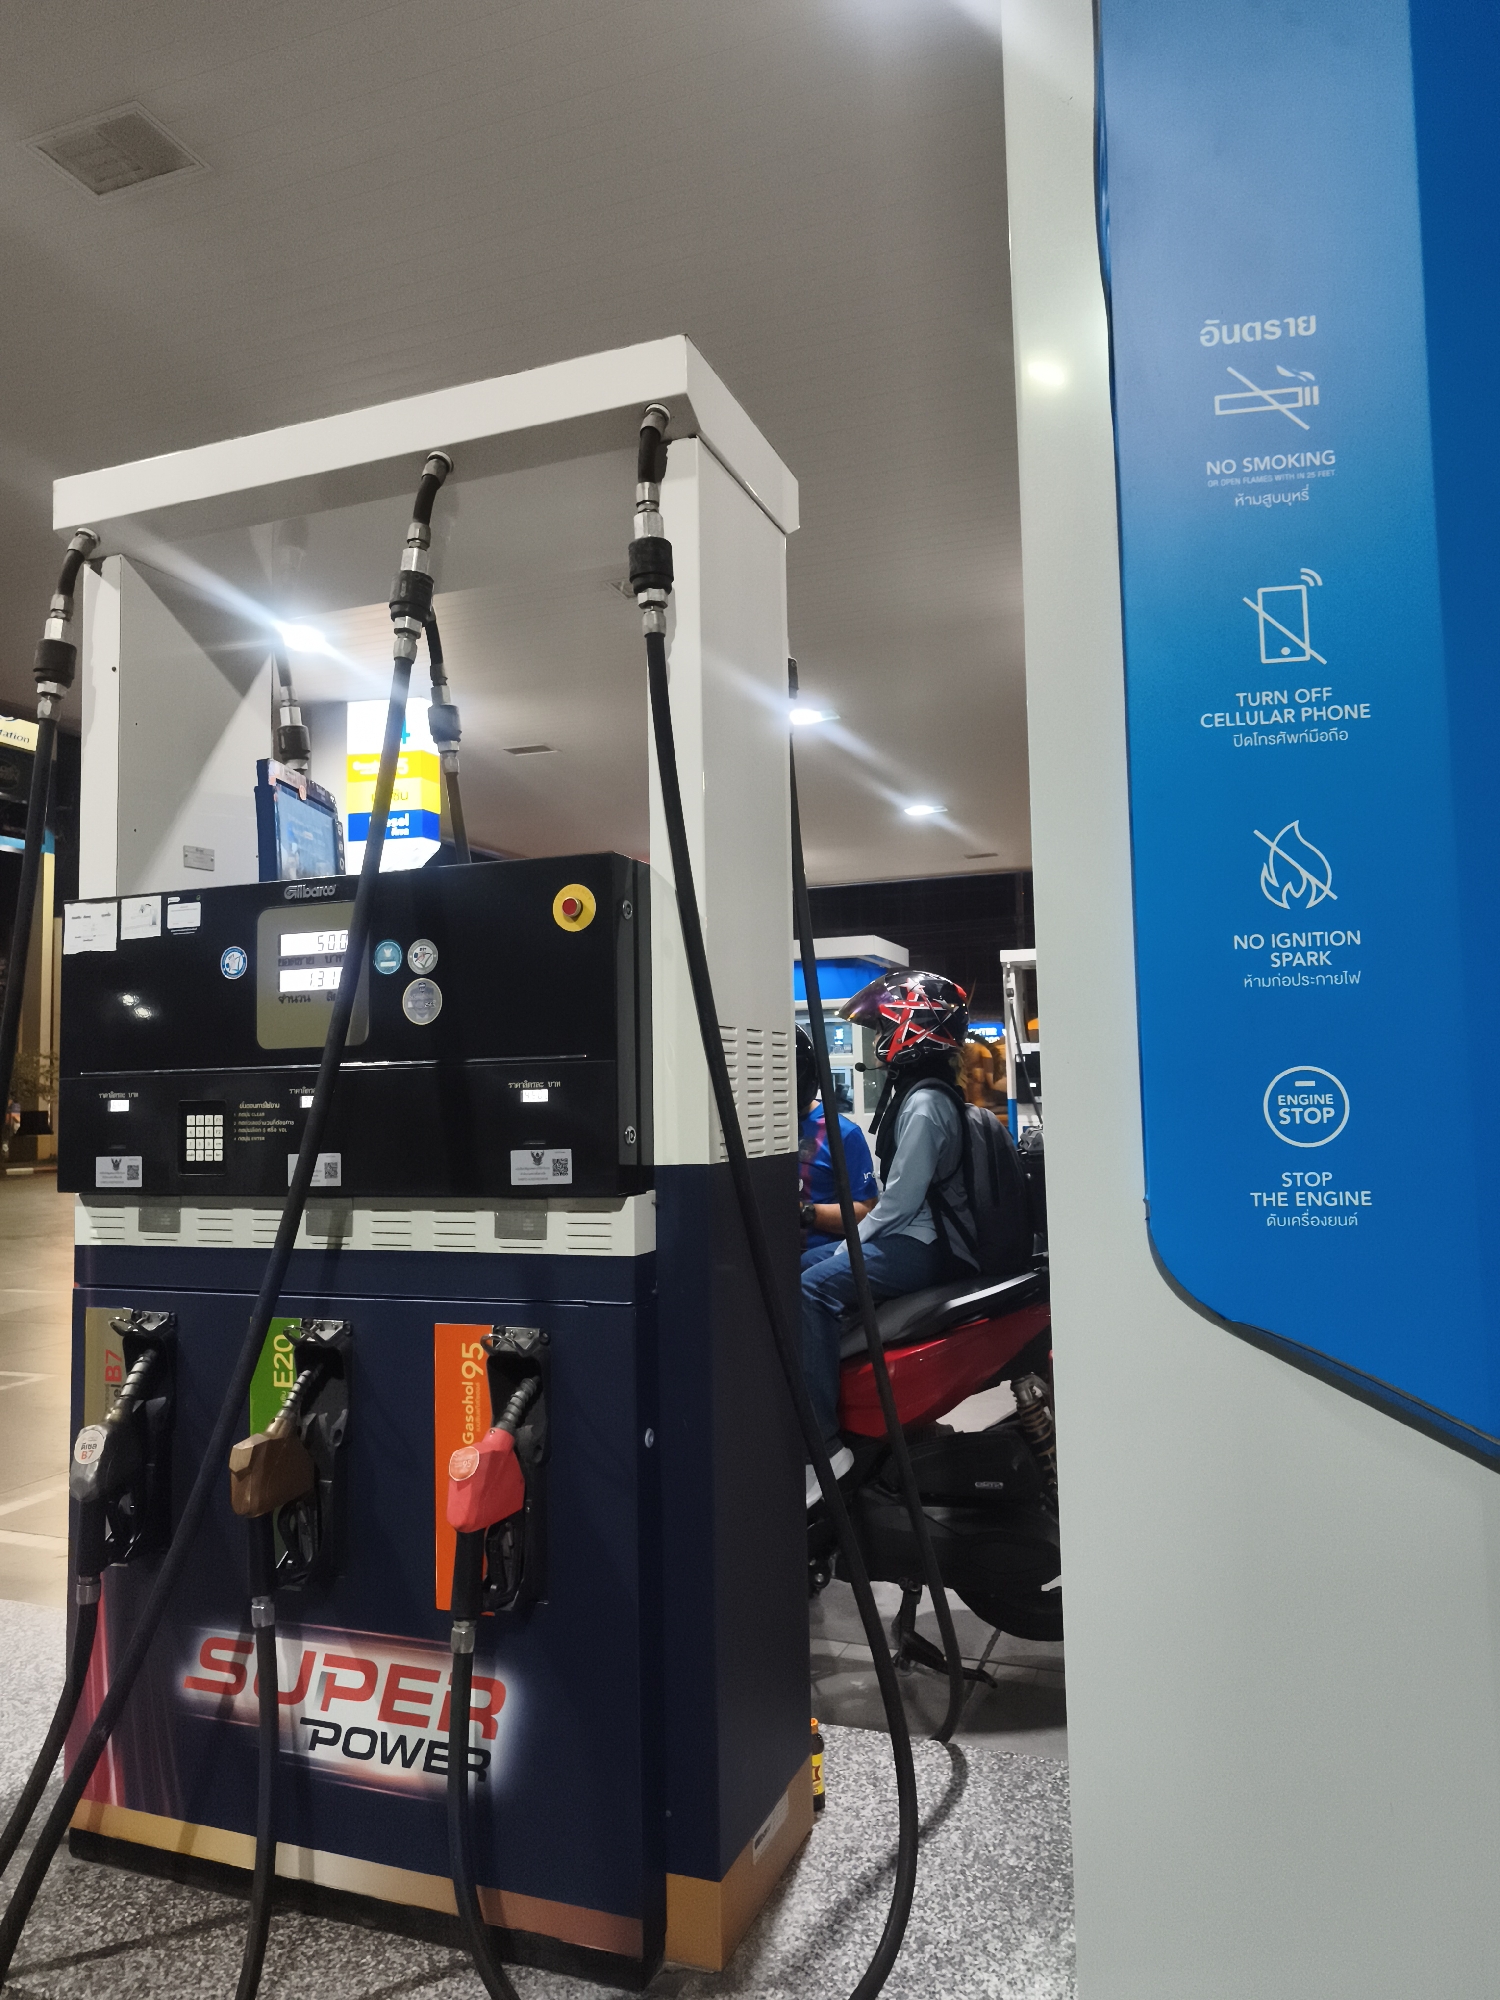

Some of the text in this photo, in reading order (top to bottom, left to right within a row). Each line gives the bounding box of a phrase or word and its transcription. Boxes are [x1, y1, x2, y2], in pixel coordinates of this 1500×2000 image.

[1199, 315, 1317, 347] อันตราย
[1206, 449, 1336, 475] NO SMOKING
[1207, 479, 1219, 488] OR
[1220, 477, 1241, 487] OPEN
[1243, 474, 1273, 484] FLAMES
[1274, 472, 1295, 482] WITH
[1297, 471, 1306, 480] IN
[1306, 470, 1316, 479] 25
[1234, 483, 1310, 508] ห้ามสูบบุหรี่
[1235, 686, 1333, 707] TURN OFF
[1200, 703, 1372, 728] CELLULAR PHONE
[1233, 727, 1349, 748] ปิดโทรศัพท์มือถือ
[284, 883, 337, 900] Gilbarco
[1233, 930, 1362, 950] NO IGNITION
[1270, 950, 1333, 968] SPARK
[1243, 970, 1362, 988] ห้ามก่อประกายไฟ
[1277, 1093, 1335, 1106] ENGINE
[1278, 1107, 1336, 1125] STOP
[1281, 1171, 1333, 1188] STOP
[1249, 1190, 1373, 1208] THE ENGINE
[1266, 1208, 1359, 1227] ดับเครื่องยนต์
[104, 1348, 123, 1383] B7
[273, 1334, 294, 1388] E20
[461, 1342, 484, 1445] Gasohol 95
[80, 1450, 95, 1460] B7
[183, 1636, 507, 1740] SUPER
[299, 1716, 492, 1783] POWER
